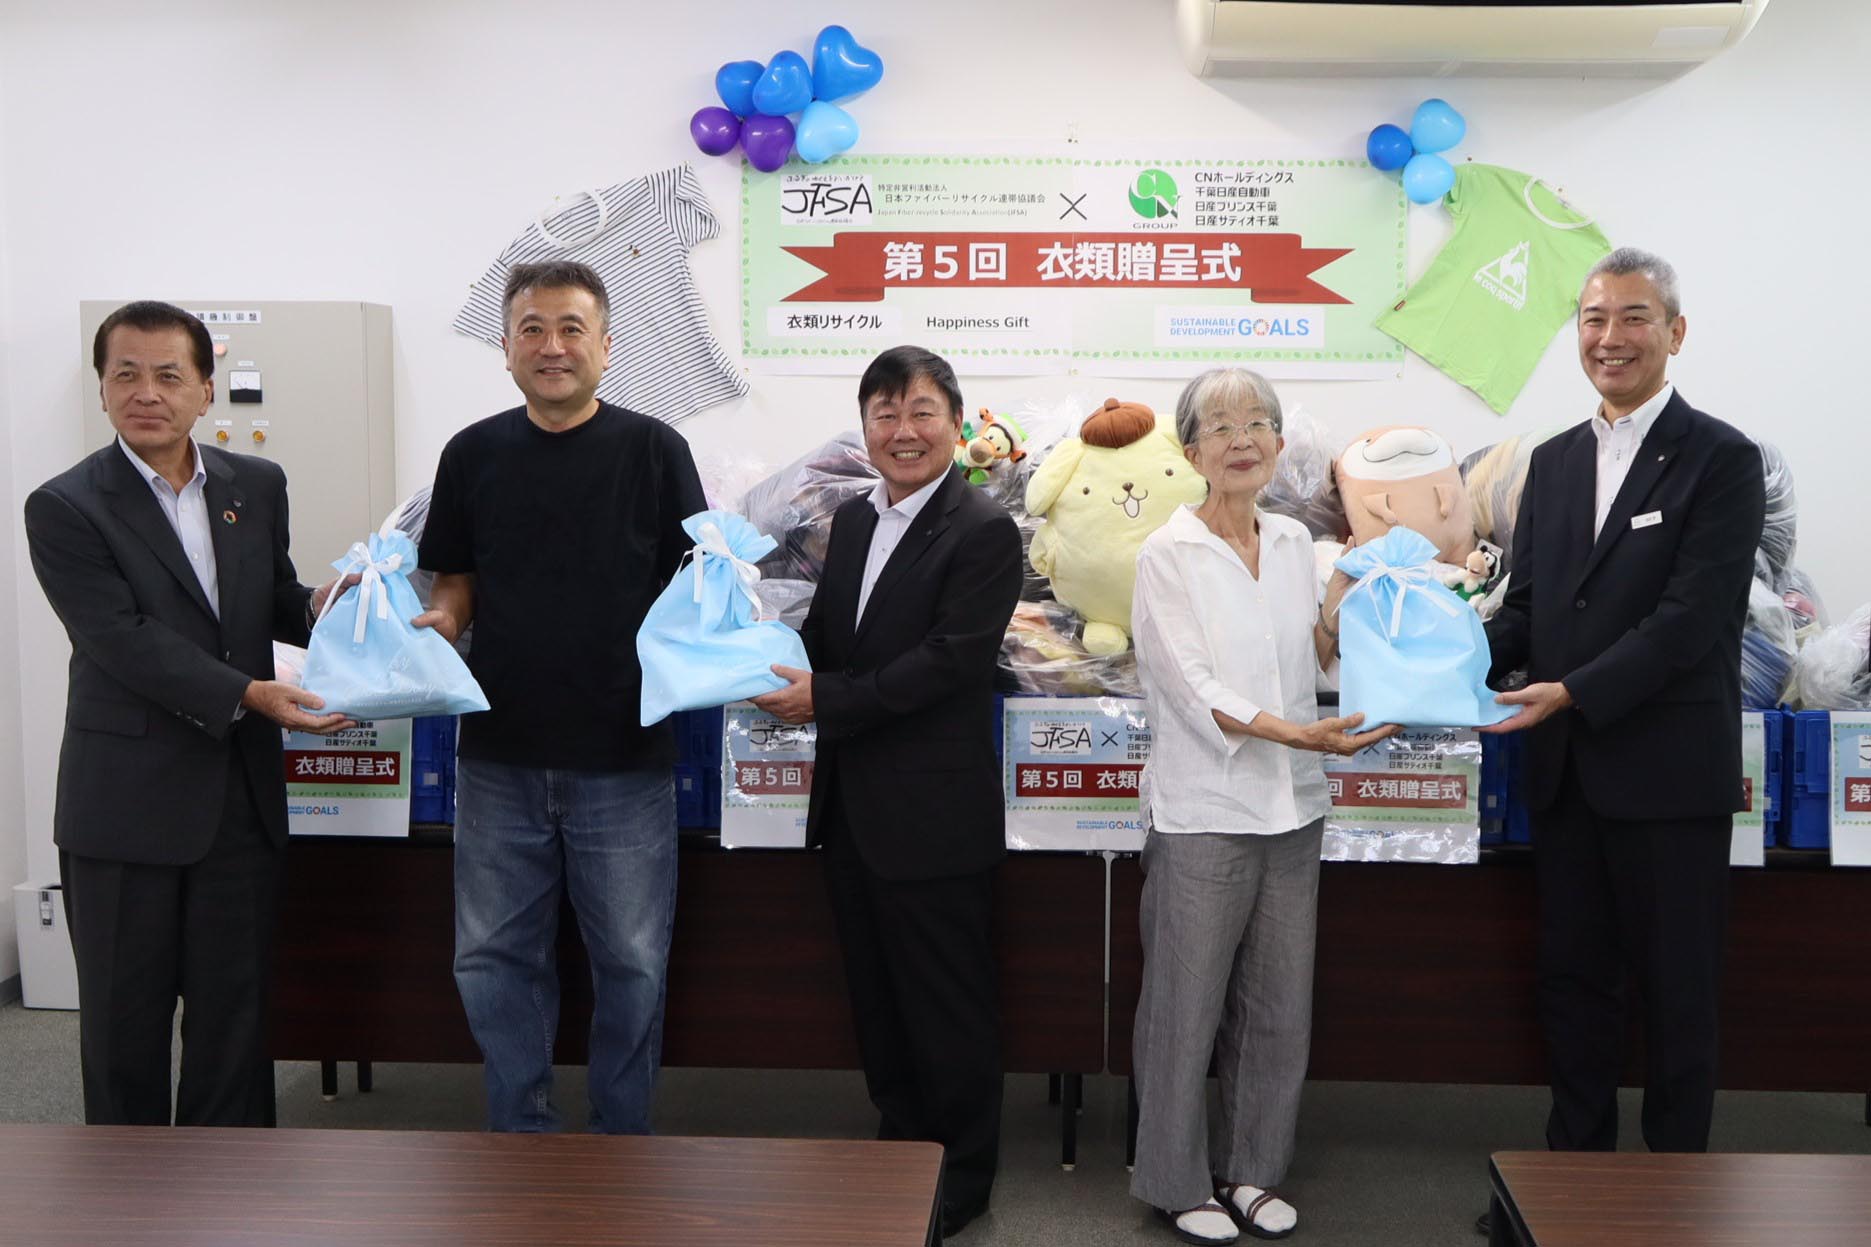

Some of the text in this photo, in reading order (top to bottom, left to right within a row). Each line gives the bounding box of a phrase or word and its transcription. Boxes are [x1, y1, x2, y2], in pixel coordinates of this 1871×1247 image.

[1194, 172, 1294, 183] CNホールディングス
[885, 194, 1046, 204] 日本ファイバーリサイクル連帯協議会
[1195, 187, 1271, 198] 千葉日産自動車
[782, 183, 872, 217] JFSA
[1195, 201, 1278, 212] 日産プリンス千葉
[1195, 215, 1280, 227] 日産サティオ千葉
[883, 241, 1242, 282] 第5回 衣類贈呈式
[787, 315, 882, 330] 衣類リサイクル
[926, 316, 1030, 330] Happiness Gift
[1170, 318, 1236, 327] SUSTAINABLE
[1238, 318, 1310, 336] GOALS
[1170, 328, 1236, 336] DEVELOPMENT
[295, 756, 395, 777] 衣類贈呈式
[741, 766, 801, 787] 第5回
[1021, 769, 1143, 790] 第5回 衣類
[1357, 779, 1461, 800] 衣類贈呈式
[306, 806, 339, 815] GOALS
[1108, 820, 1144, 829] GOALS
